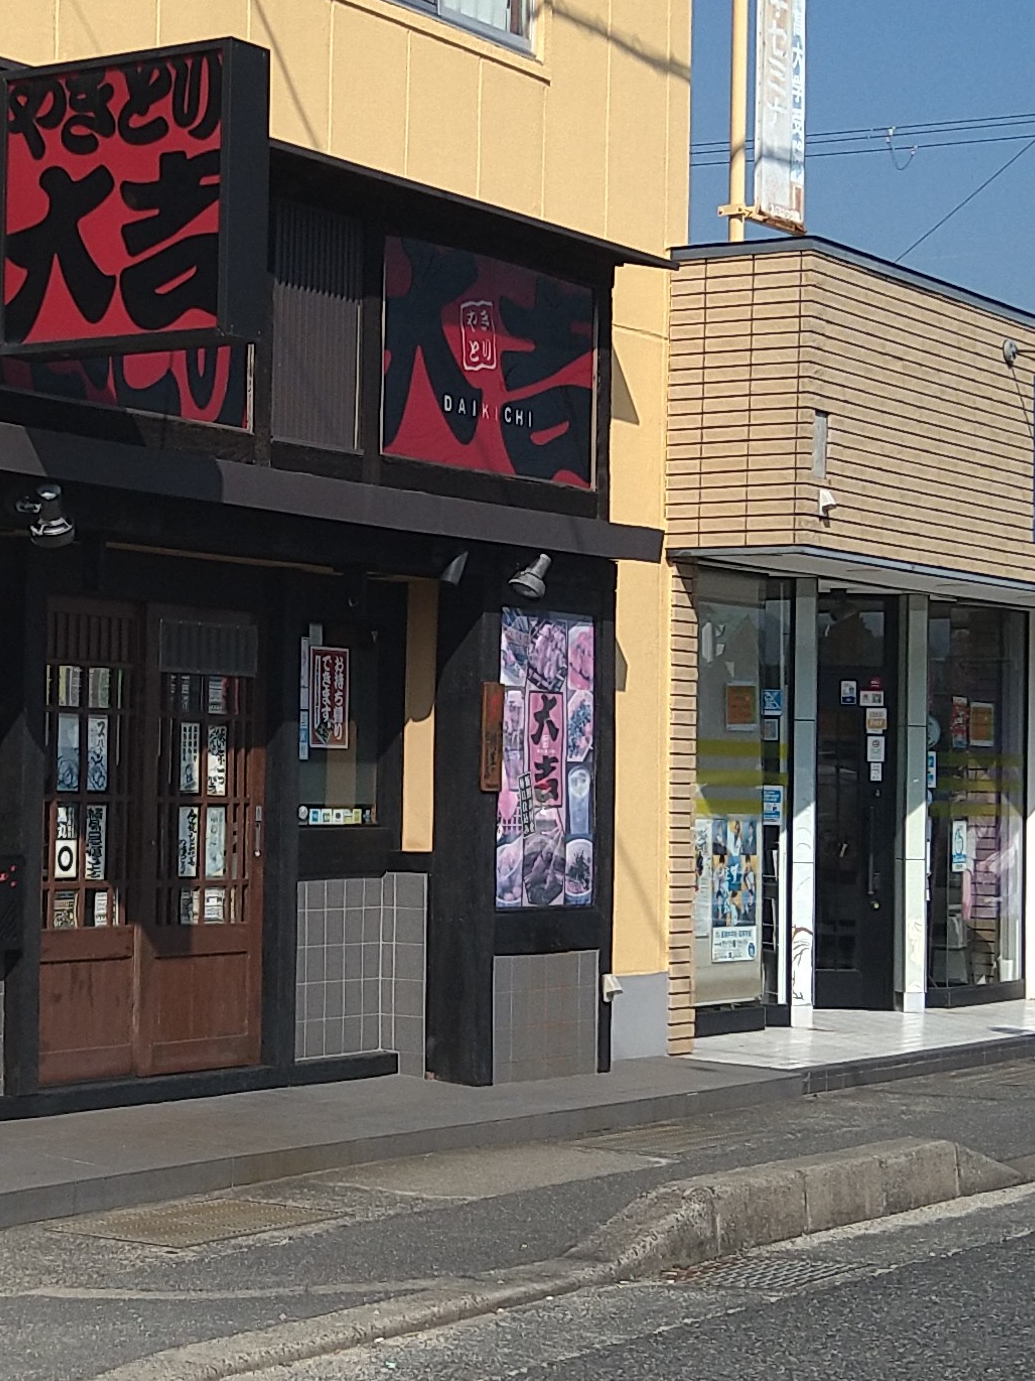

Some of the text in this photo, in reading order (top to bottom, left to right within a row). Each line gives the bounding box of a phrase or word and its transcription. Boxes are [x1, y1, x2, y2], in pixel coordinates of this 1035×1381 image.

[8, 56, 222, 160] やきとり
[4, 149, 220, 343] 大吉
[444, 394, 533, 428] DAIKICHI
